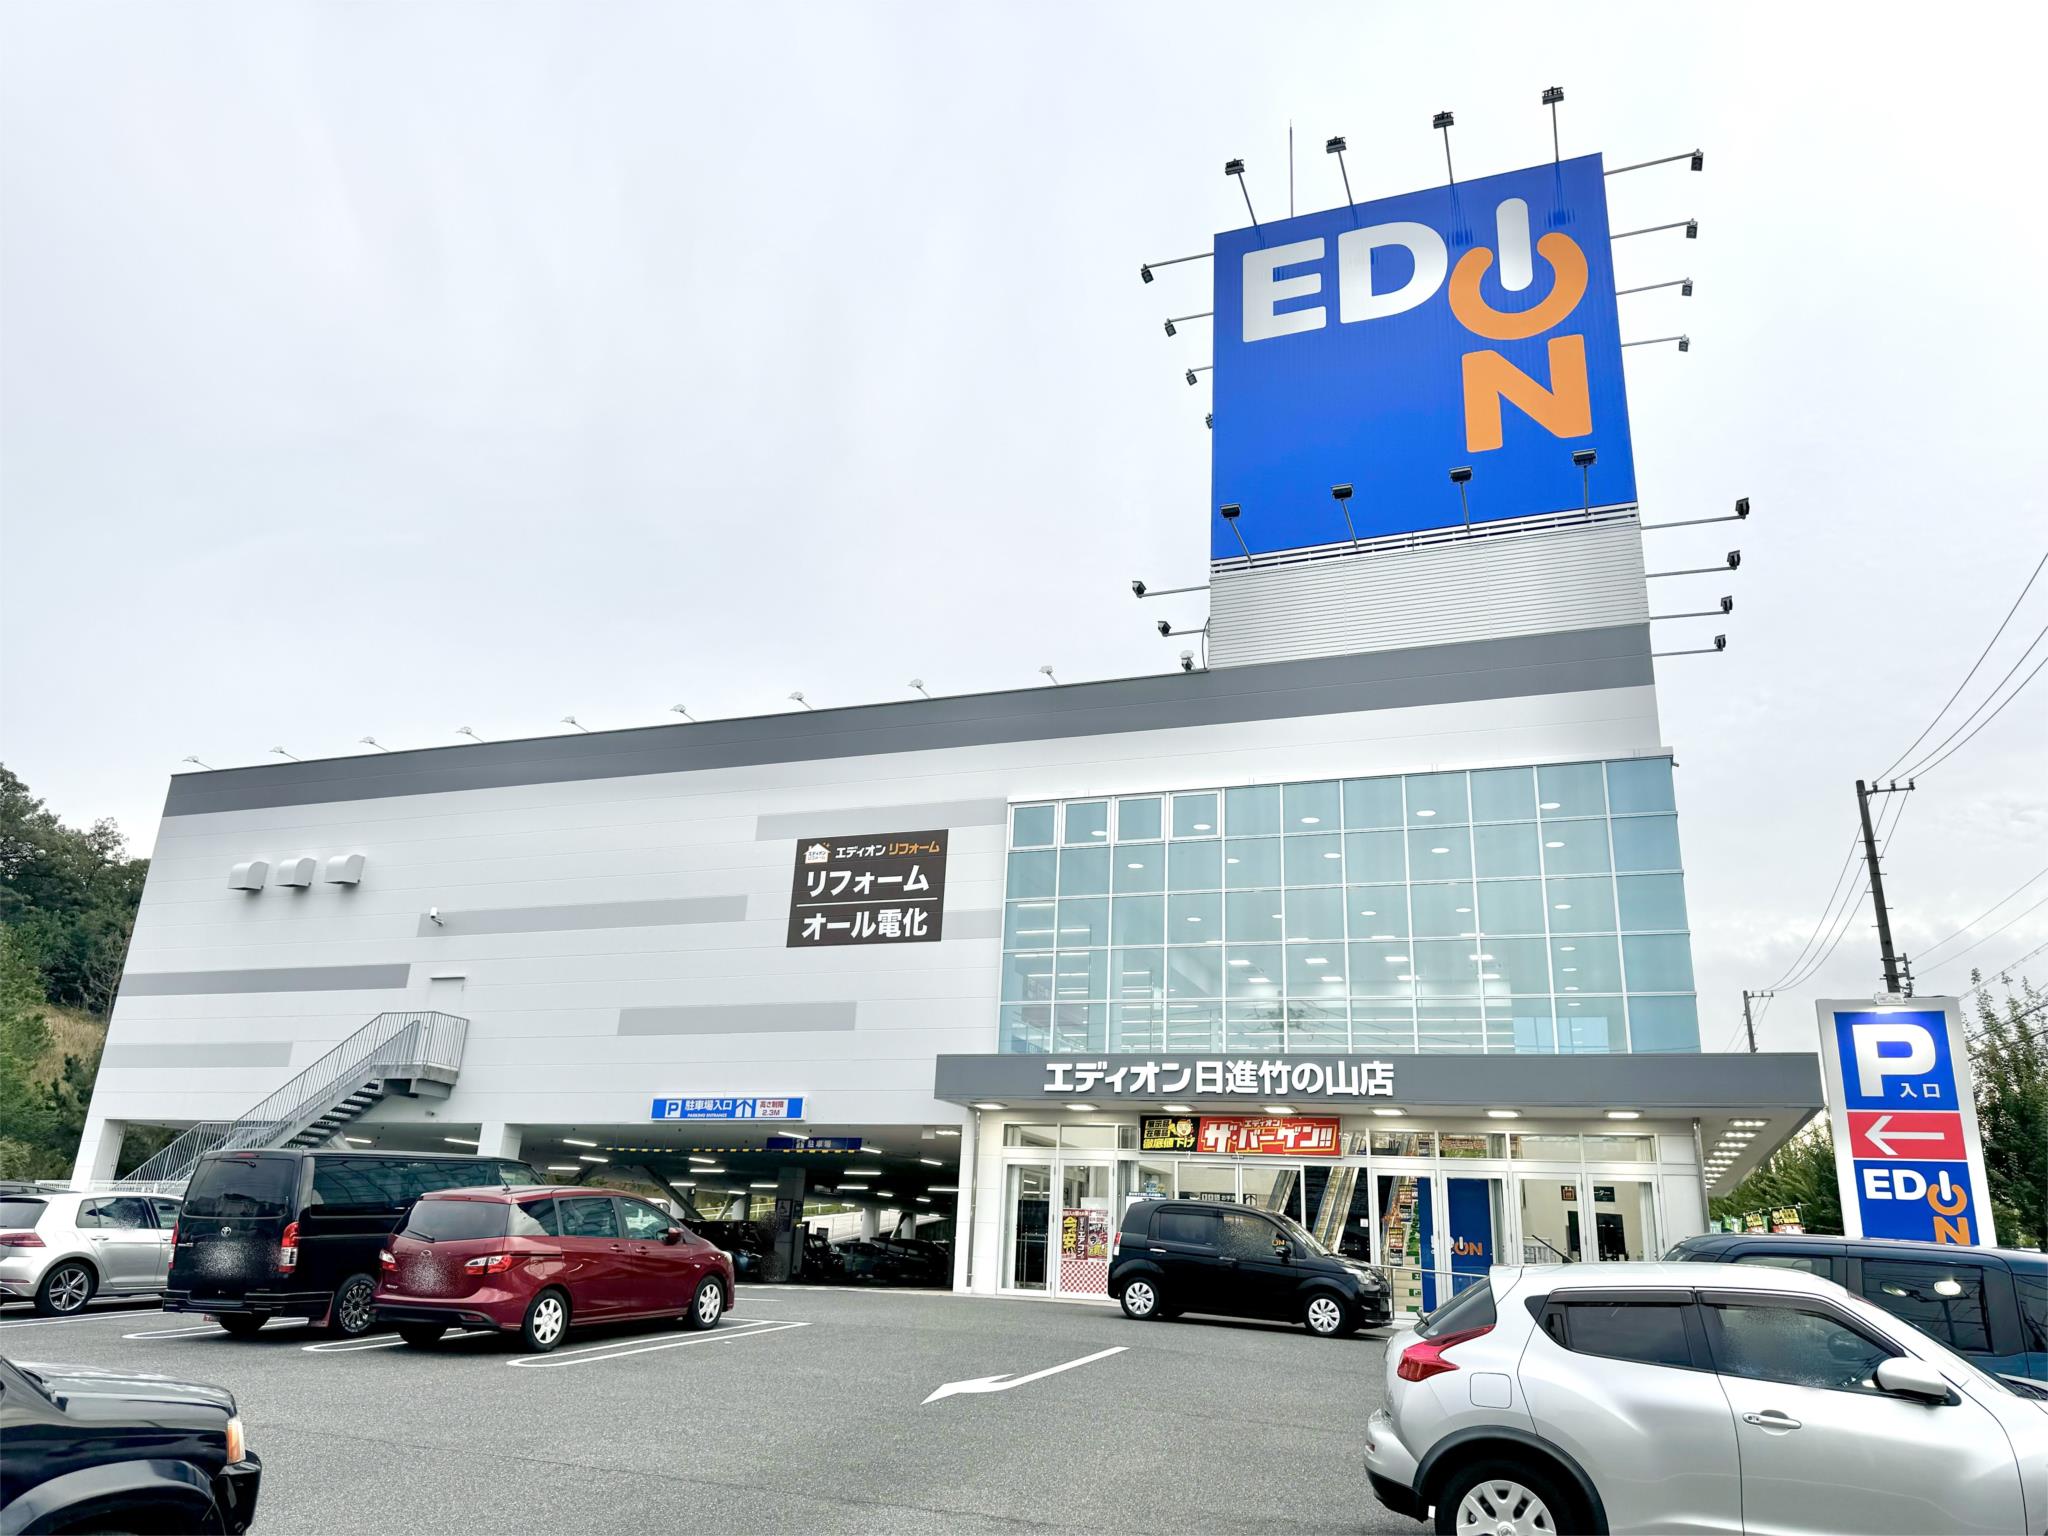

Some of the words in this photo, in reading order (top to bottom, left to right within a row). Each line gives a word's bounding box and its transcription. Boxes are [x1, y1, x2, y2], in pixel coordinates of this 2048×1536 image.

[835, 844, 886, 859] エディオン
[889, 841, 940, 856] リフォーム
[807, 865, 929, 897] リフォーム
[801, 907, 928, 940] オール電化
[1851, 1023, 1937, 1097] P
[1043, 1060, 1394, 1096] エディオン日進竹の山店
[1900, 1083, 1941, 1099] 入口
[685, 1099, 733, 1111] 駐車場入口
[1244, 1119, 1281, 1128] エディオン
